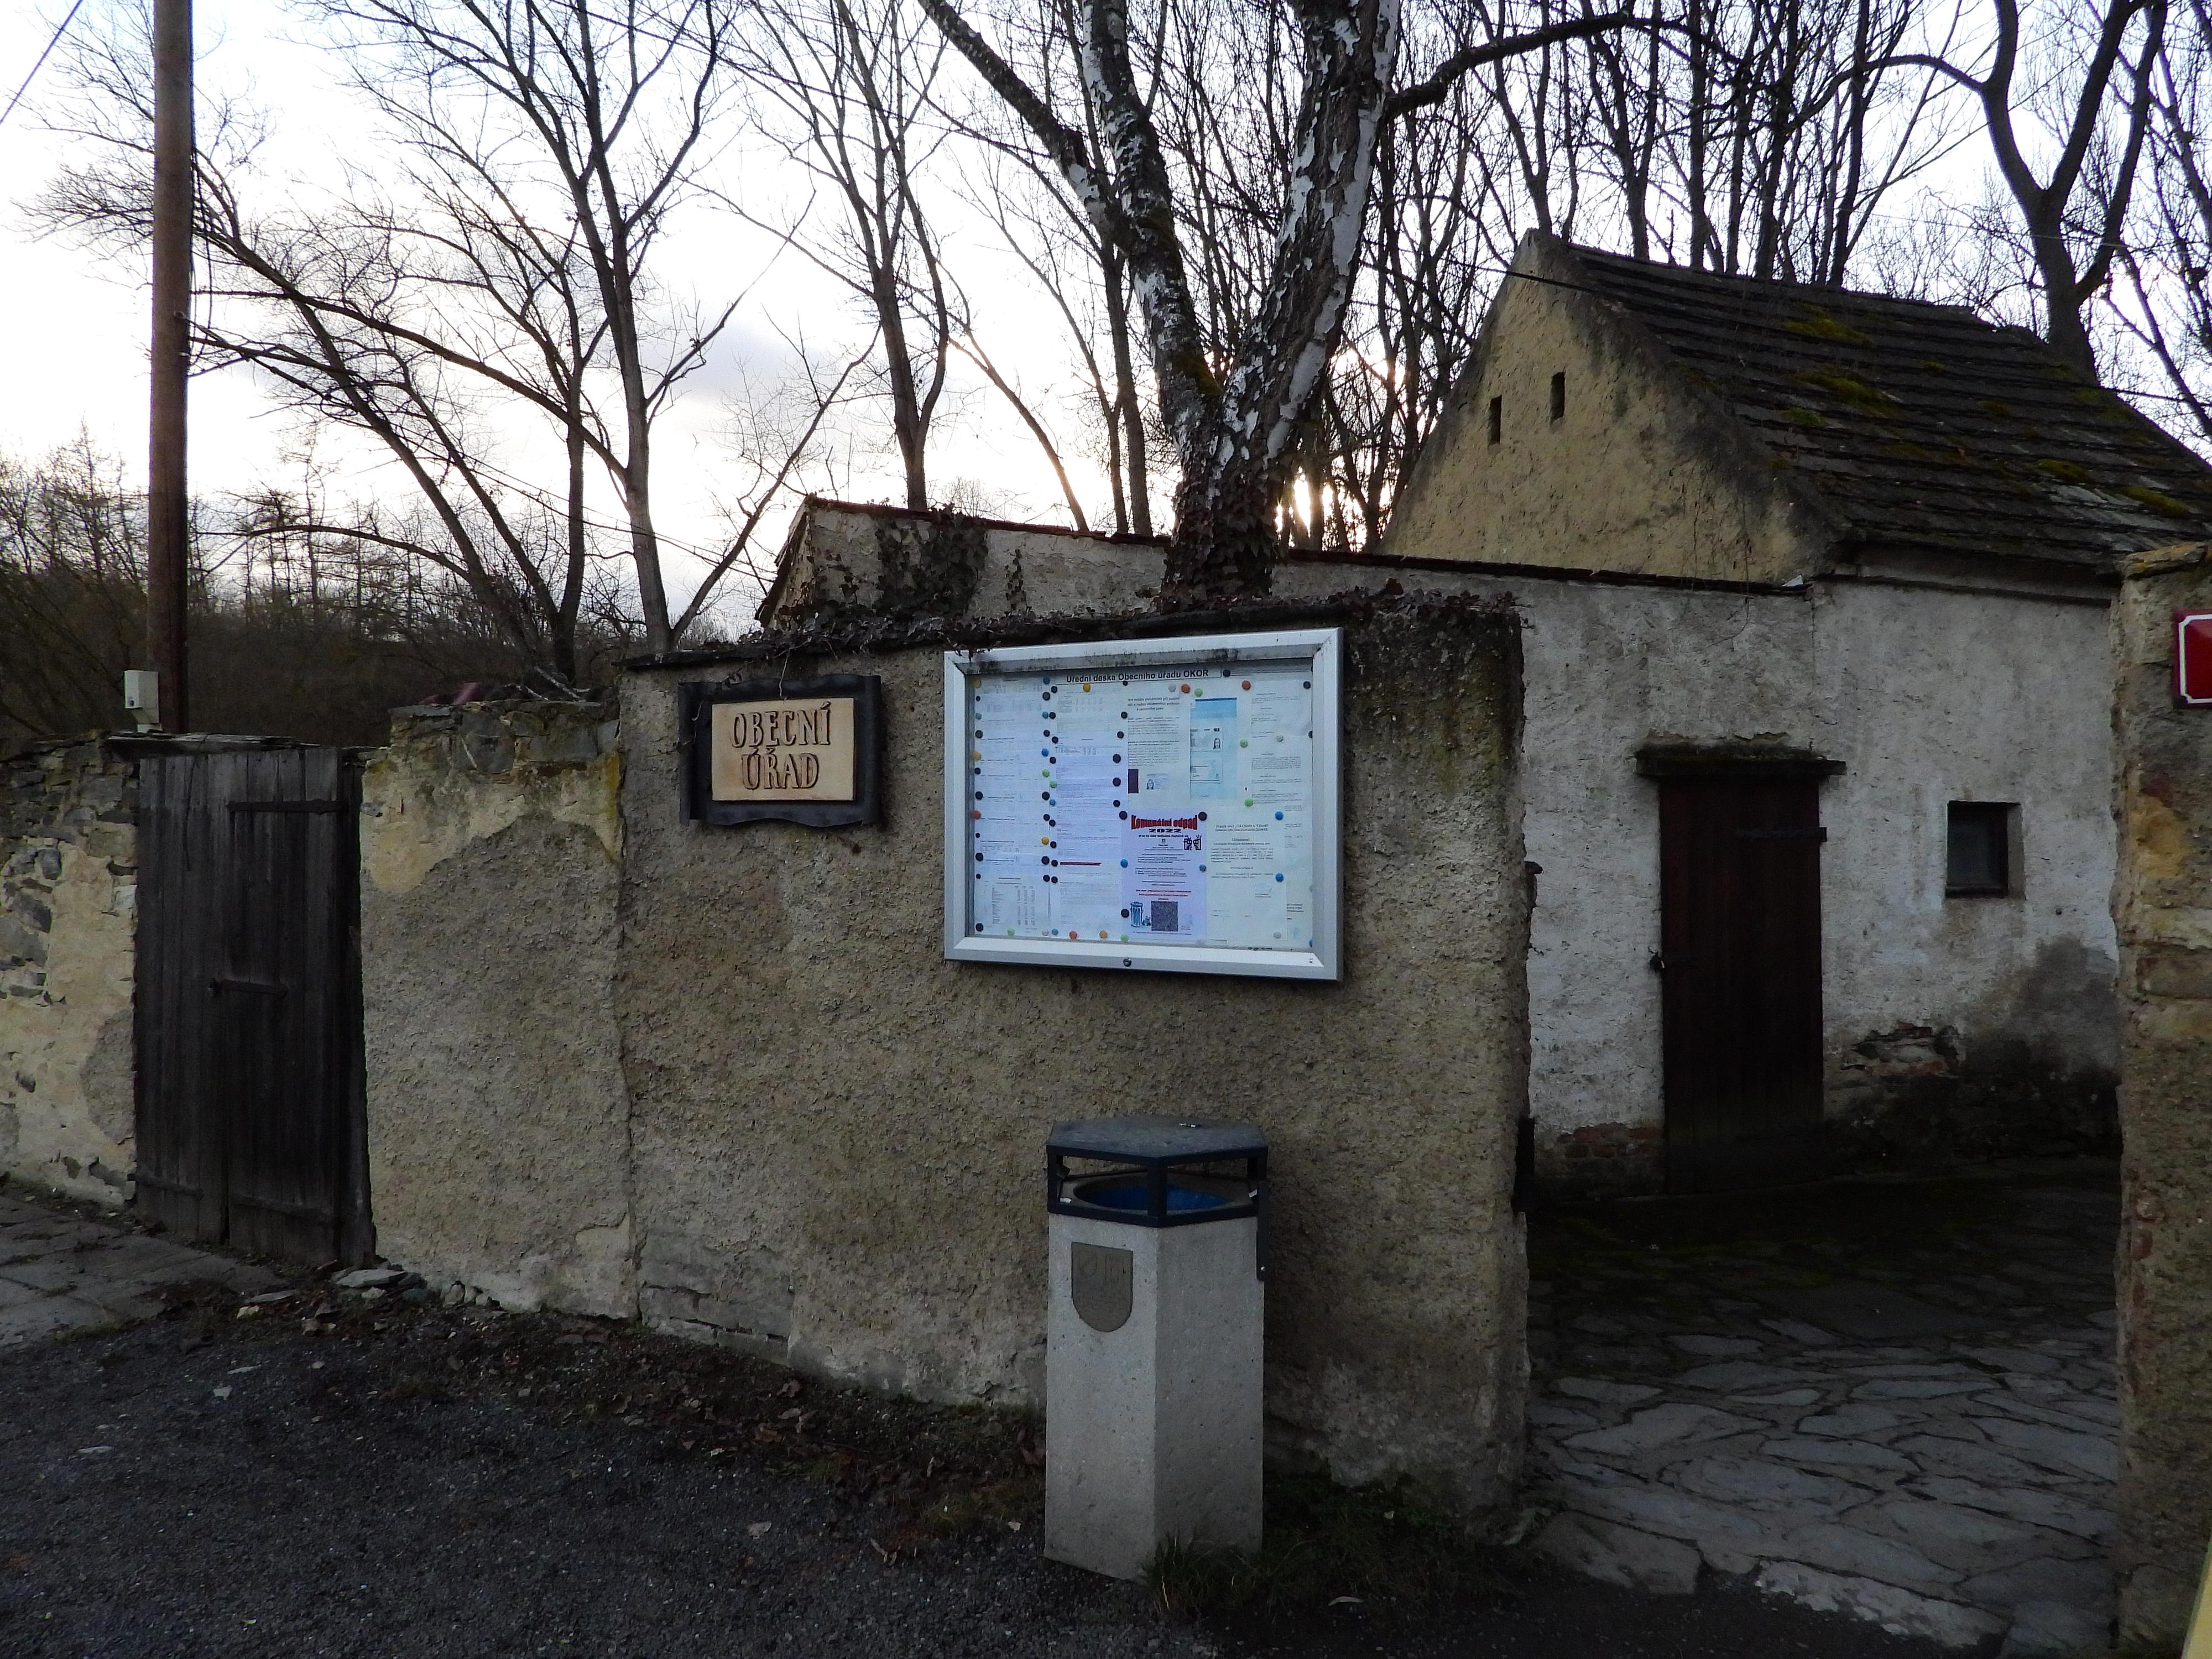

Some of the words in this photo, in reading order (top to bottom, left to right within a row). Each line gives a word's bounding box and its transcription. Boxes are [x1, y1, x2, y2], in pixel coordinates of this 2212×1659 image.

[731, 701, 831, 748] OBECNÍ
[741, 747, 819, 790] ÚŘAD
[1131, 815, 1172, 830] Komunální
[1173, 815, 1197, 830] odpad
